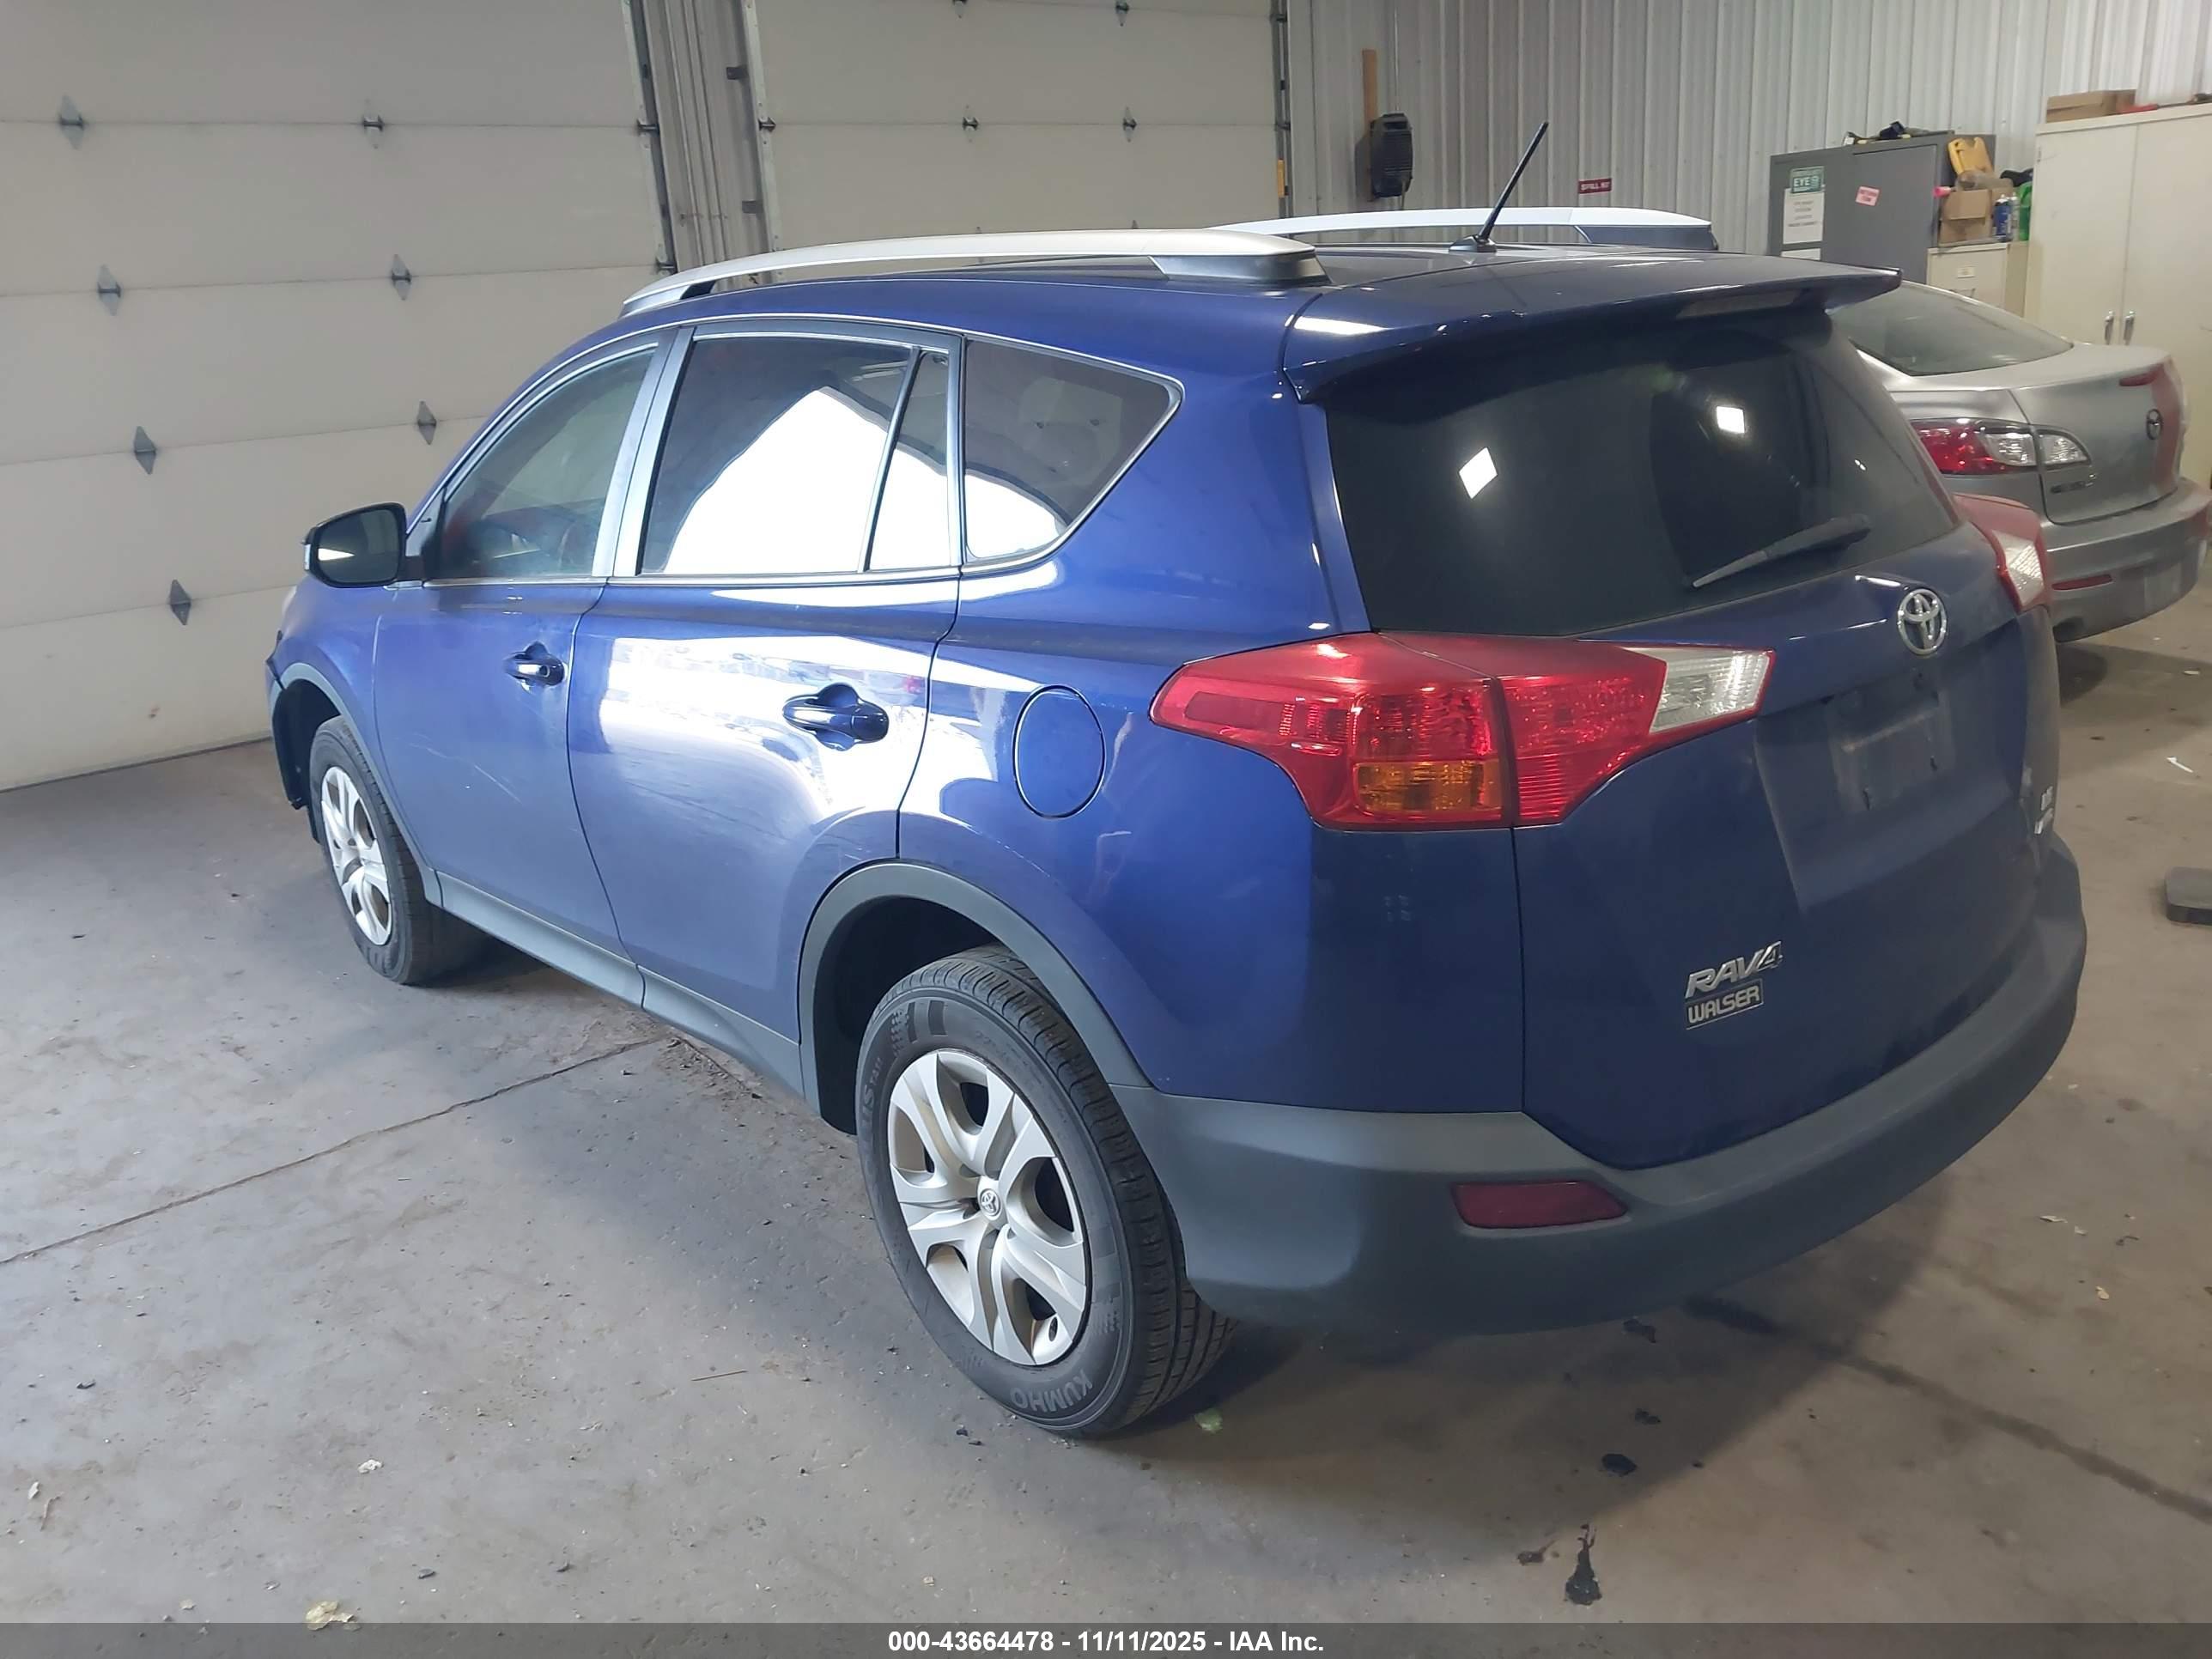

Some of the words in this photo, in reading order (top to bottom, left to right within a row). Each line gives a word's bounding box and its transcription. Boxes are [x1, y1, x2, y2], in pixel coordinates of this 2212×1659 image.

[1685, 940, 1784, 999] RAV4
[1687, 984, 1760, 1024] WALSER
[1010, 1369, 1093, 1413] KUMHO
